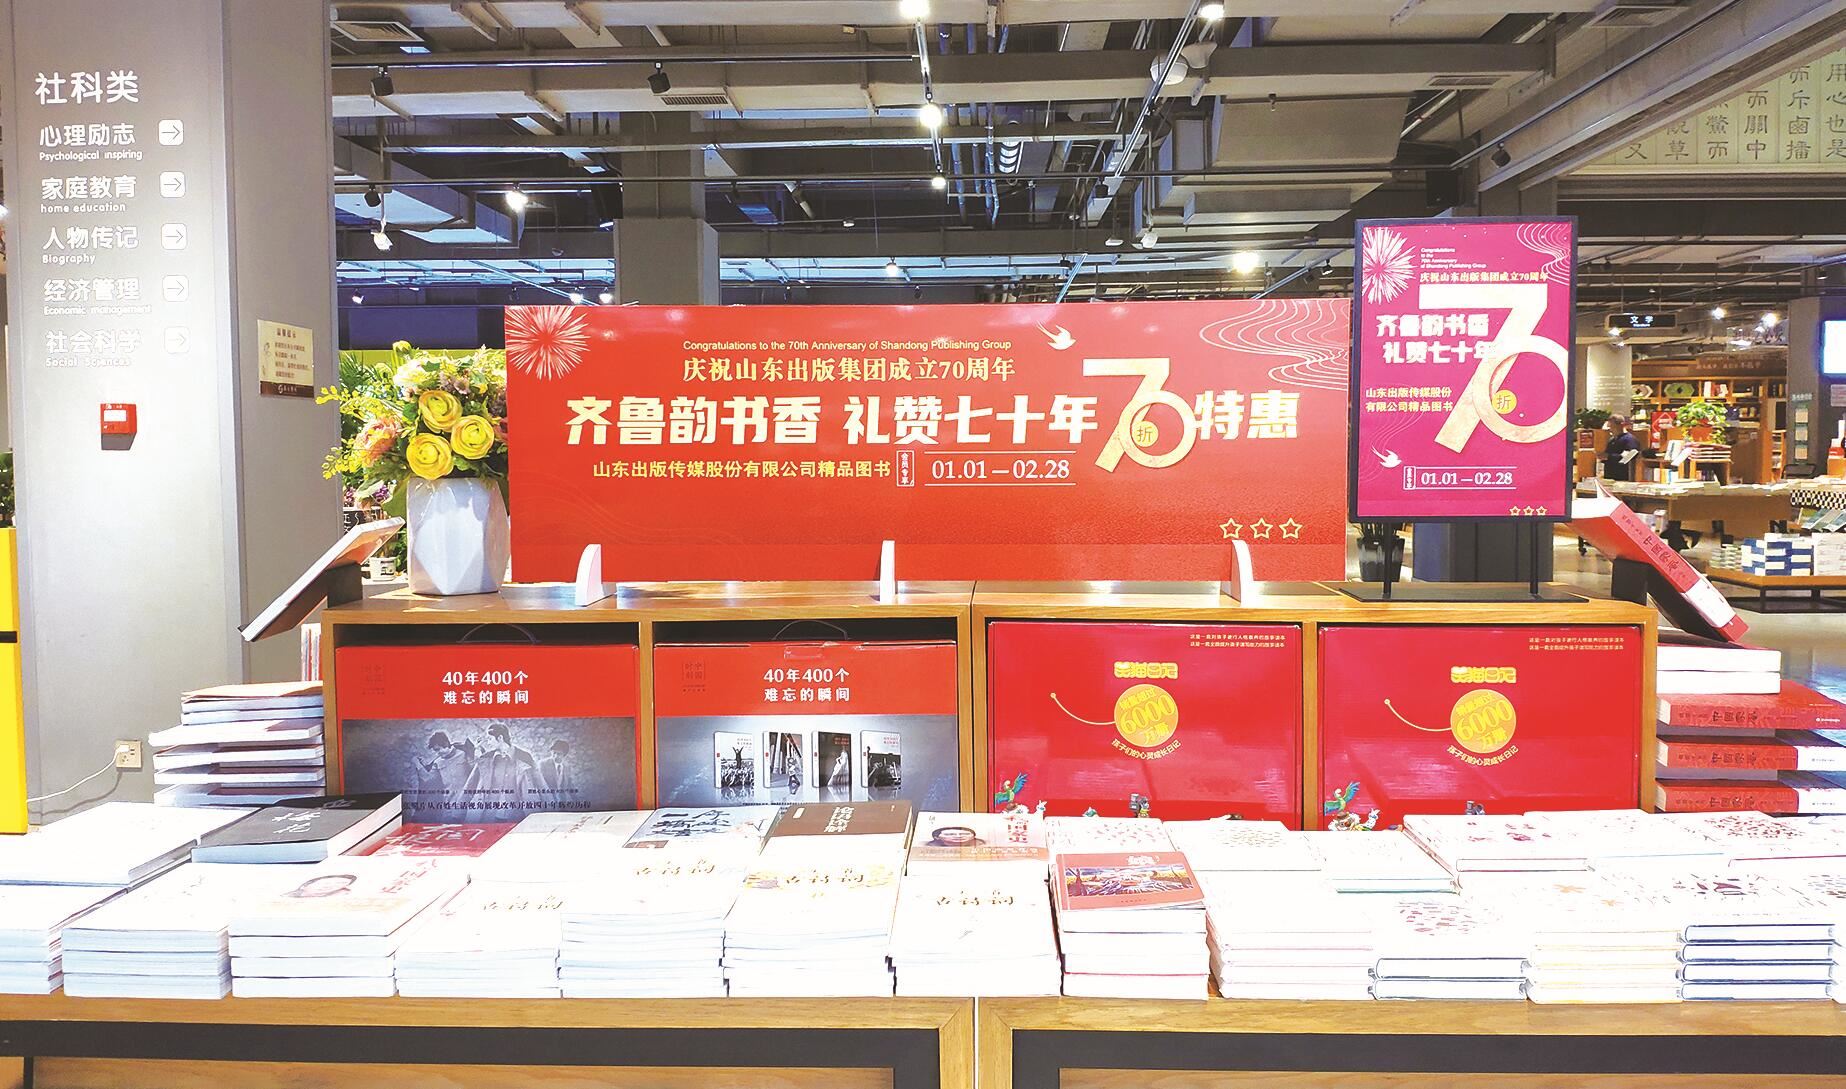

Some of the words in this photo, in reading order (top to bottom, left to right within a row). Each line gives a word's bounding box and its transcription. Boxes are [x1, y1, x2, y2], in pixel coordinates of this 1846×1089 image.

[35, 70, 139, 105] 社科类
[39, 123, 136, 147] 心理励志
[39, 150, 99, 162] Psychological
[41, 175, 137, 200] 家庭教育
[40, 204, 69, 213] home
[73, 202, 126, 213] education
[42, 225, 139, 250] 人物传记
[42, 254, 96, 265] Biography
[43, 277, 140, 302] 经济管理
[45, 329, 143, 354] 社会科学
[683, 340, 757, 350] Congratulations
[760, 341, 769, 350] to
[772, 340, 786, 350] the
[789, 341, 809, 350] 70th
[811, 341, 866, 352] Anniversary
[869, 340, 879, 350] of
[881, 340, 929, 352] Shandong
[931, 339, 980, 351] Publishing
[982, 340, 1012, 350] Group
[683, 357, 1016, 383] 庆祝山东出版集团成立70周年
[1366, 387, 1452, 398] 山东出版传媒股份
[1366, 402, 1453, 412] 有限公司精品图书
[1496, 394, 1511, 409] 折
[566, 395, 821, 445] 齐鲁韵书香
[843, 393, 1098, 445] 礼赞七十年
[1194, 389, 1300, 440] 特惠
[1137, 427, 1152, 443] 折
[593, 461, 891, 478] 山东出版传媒股份有限公司精品图书
[442, 671, 529, 686] 40年400个
[764, 668, 850, 683] 40年400个
[443, 690, 529, 704] 难忘的瞬间
[764, 687, 849, 702] 难忘的瞬间
[1120, 694, 1175, 735] 6000
[1456, 700, 1513, 741] 6000
